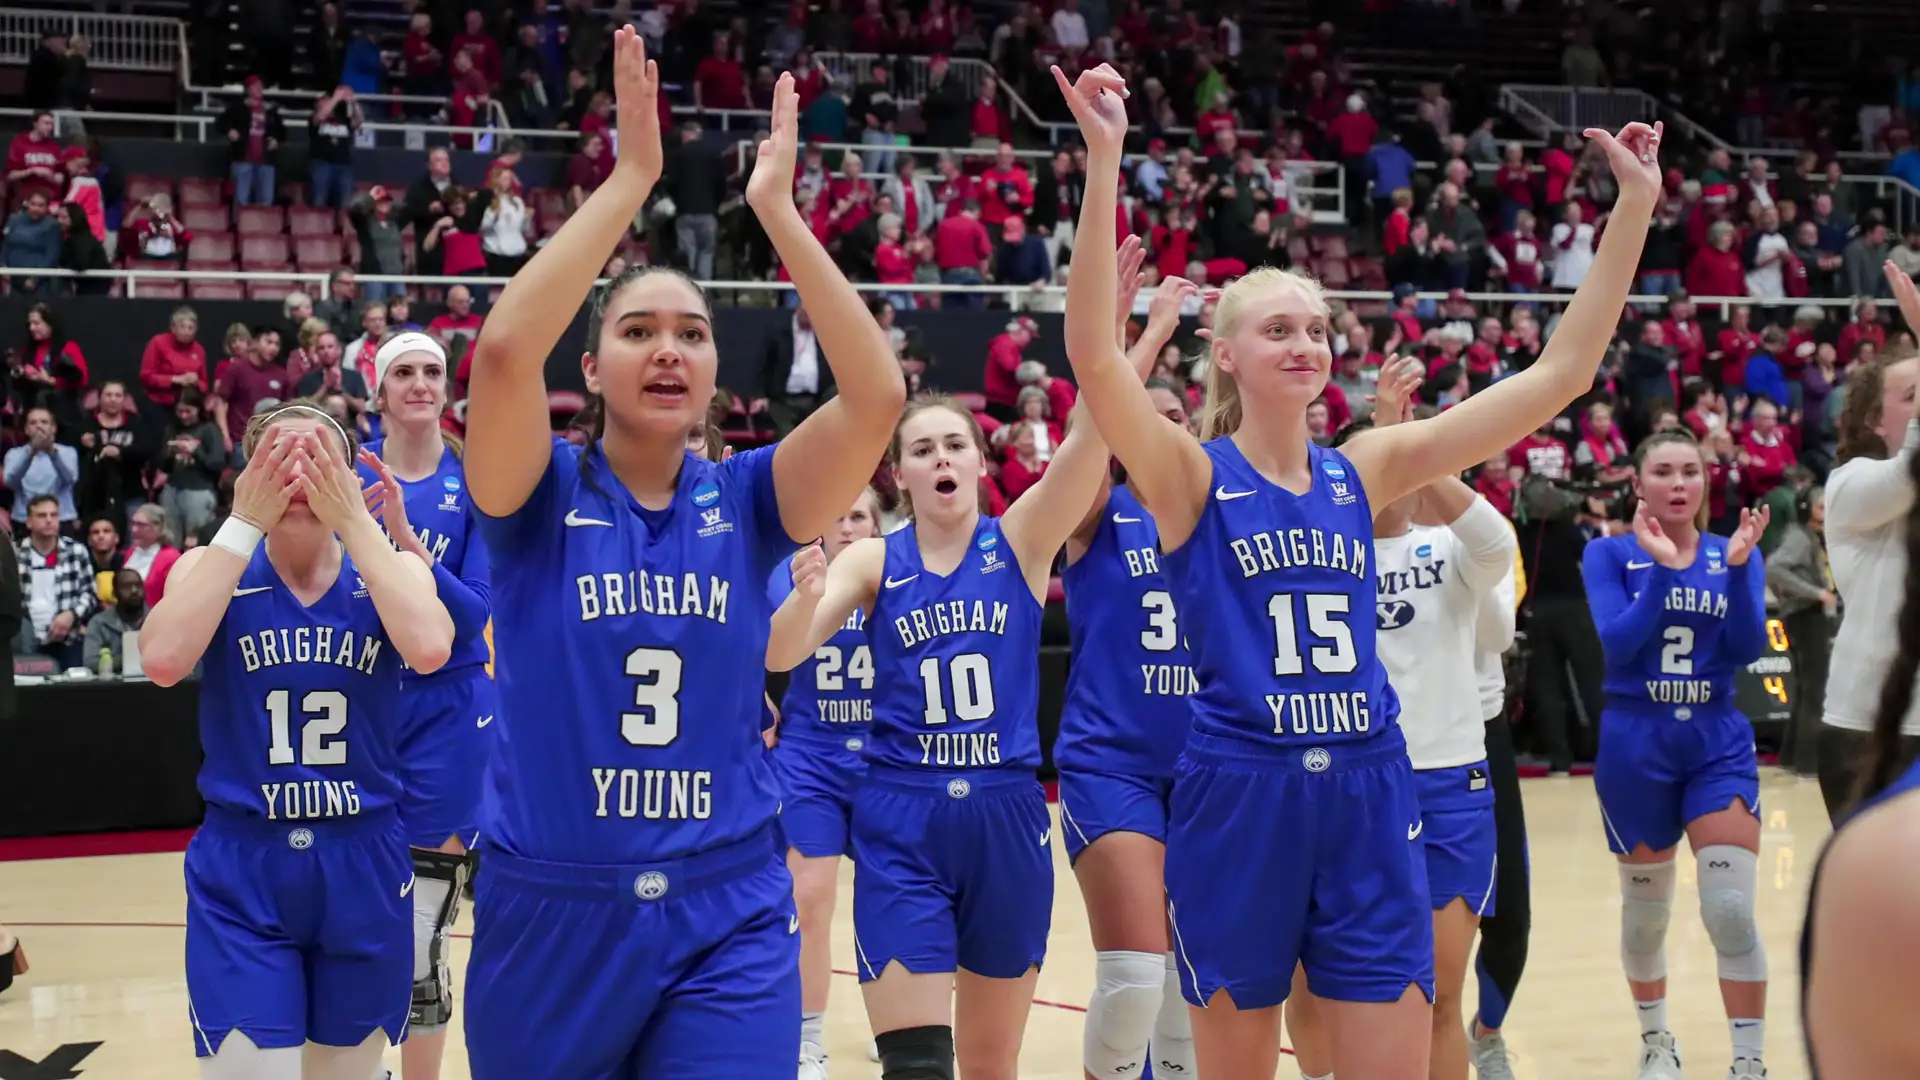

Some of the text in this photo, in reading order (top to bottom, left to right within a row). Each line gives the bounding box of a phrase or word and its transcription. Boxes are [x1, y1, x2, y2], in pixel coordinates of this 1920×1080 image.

[1230, 528, 1366, 579] BRIGHAM
[1376, 560, 1445, 595] MILY
[576, 568, 730, 624] BRIGHAM
[1141, 590, 1189, 651] 3
[1665, 587, 1728, 619] IGHAM
[894, 600, 1009, 649] BRIGHAM
[1268, 594, 1358, 676] 15
[238, 626, 382, 676] BRIGHAM
[815, 645, 876, 690] 24
[1661, 625, 1694, 675] 2
[621, 647, 683, 746] 3
[920, 652, 996, 725] 10
[1141, 664, 1200, 696] YOUN
[1646, 680, 1711, 704] YOUNG
[1763, 676, 1788, 704] 4
[265, 690, 348, 766] 12
[817, 699, 873, 723] YOUNG
[1265, 691, 1370, 735] YOUNG
[917, 732, 1001, 766] YOUNG
[261, 780, 361, 820] YOUNG
[591, 768, 712, 820] YOUNG
